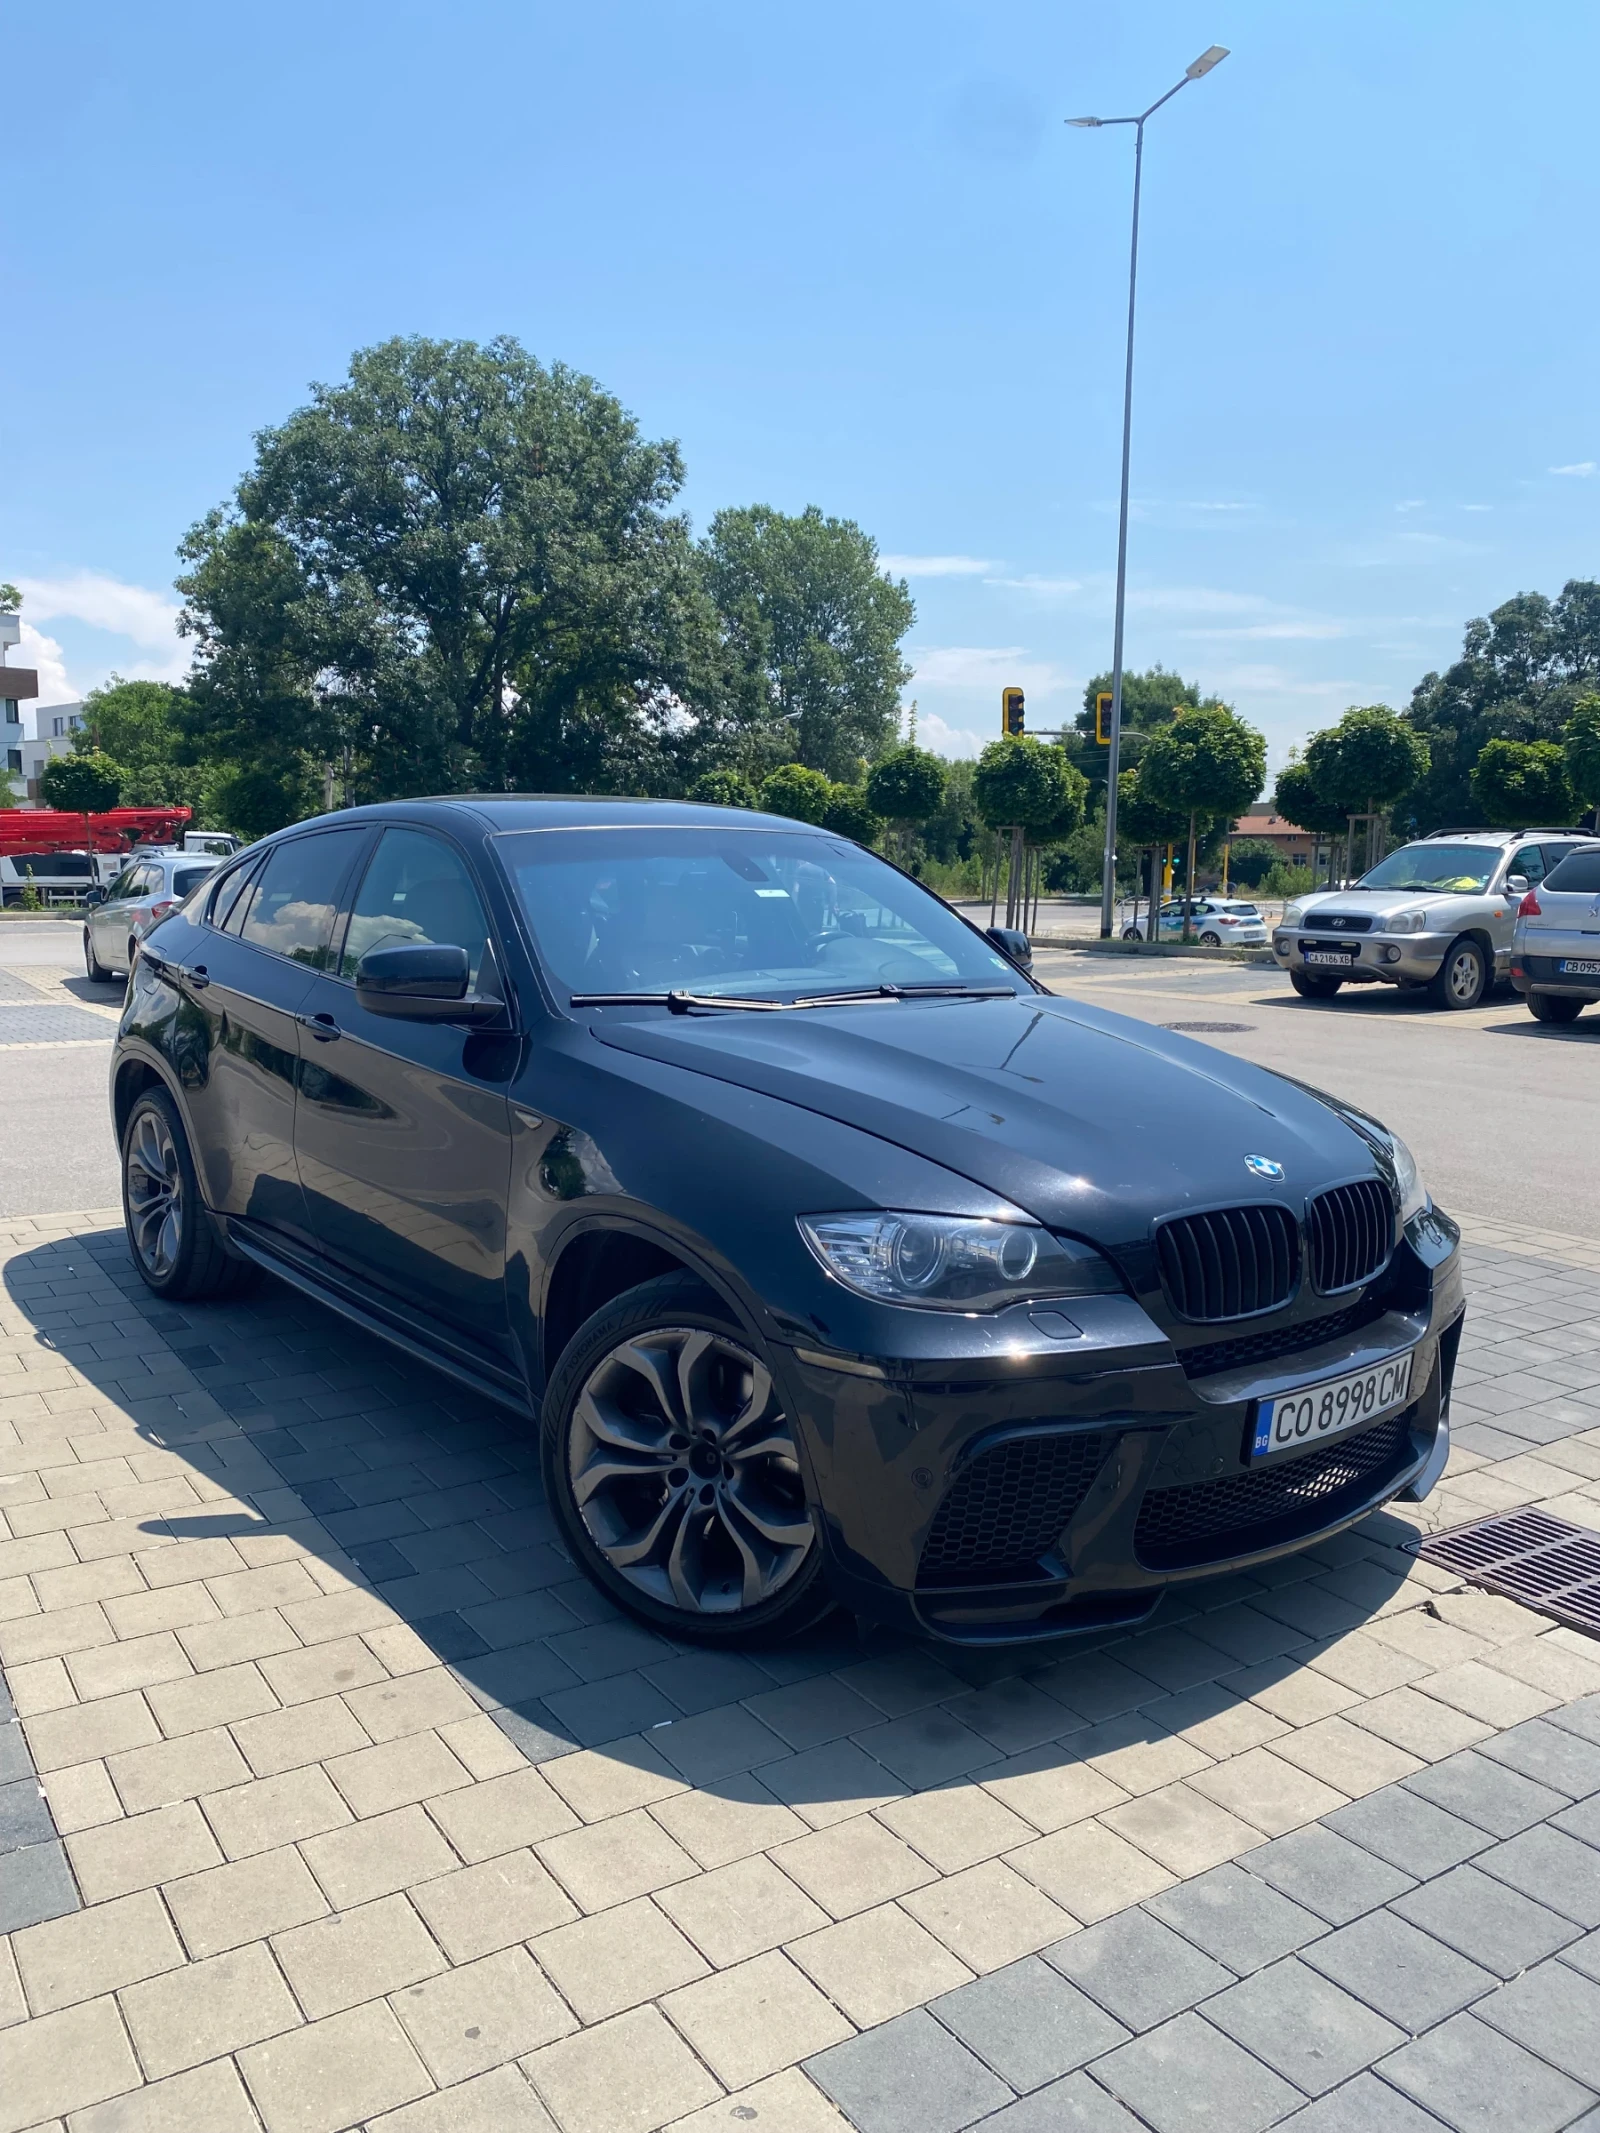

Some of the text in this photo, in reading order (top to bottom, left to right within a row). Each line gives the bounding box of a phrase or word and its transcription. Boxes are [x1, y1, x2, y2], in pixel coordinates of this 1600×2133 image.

[1309, 953, 1318, 962] CA
[1319, 954, 1338, 963] 2186
[1566, 961, 1578, 971] CB
[568, 1321, 615, 1369] YOKOHAMA
[1276, 1361, 1408, 1443] CO 8998 CM
[1255, 1435, 1268, 1448] BG
